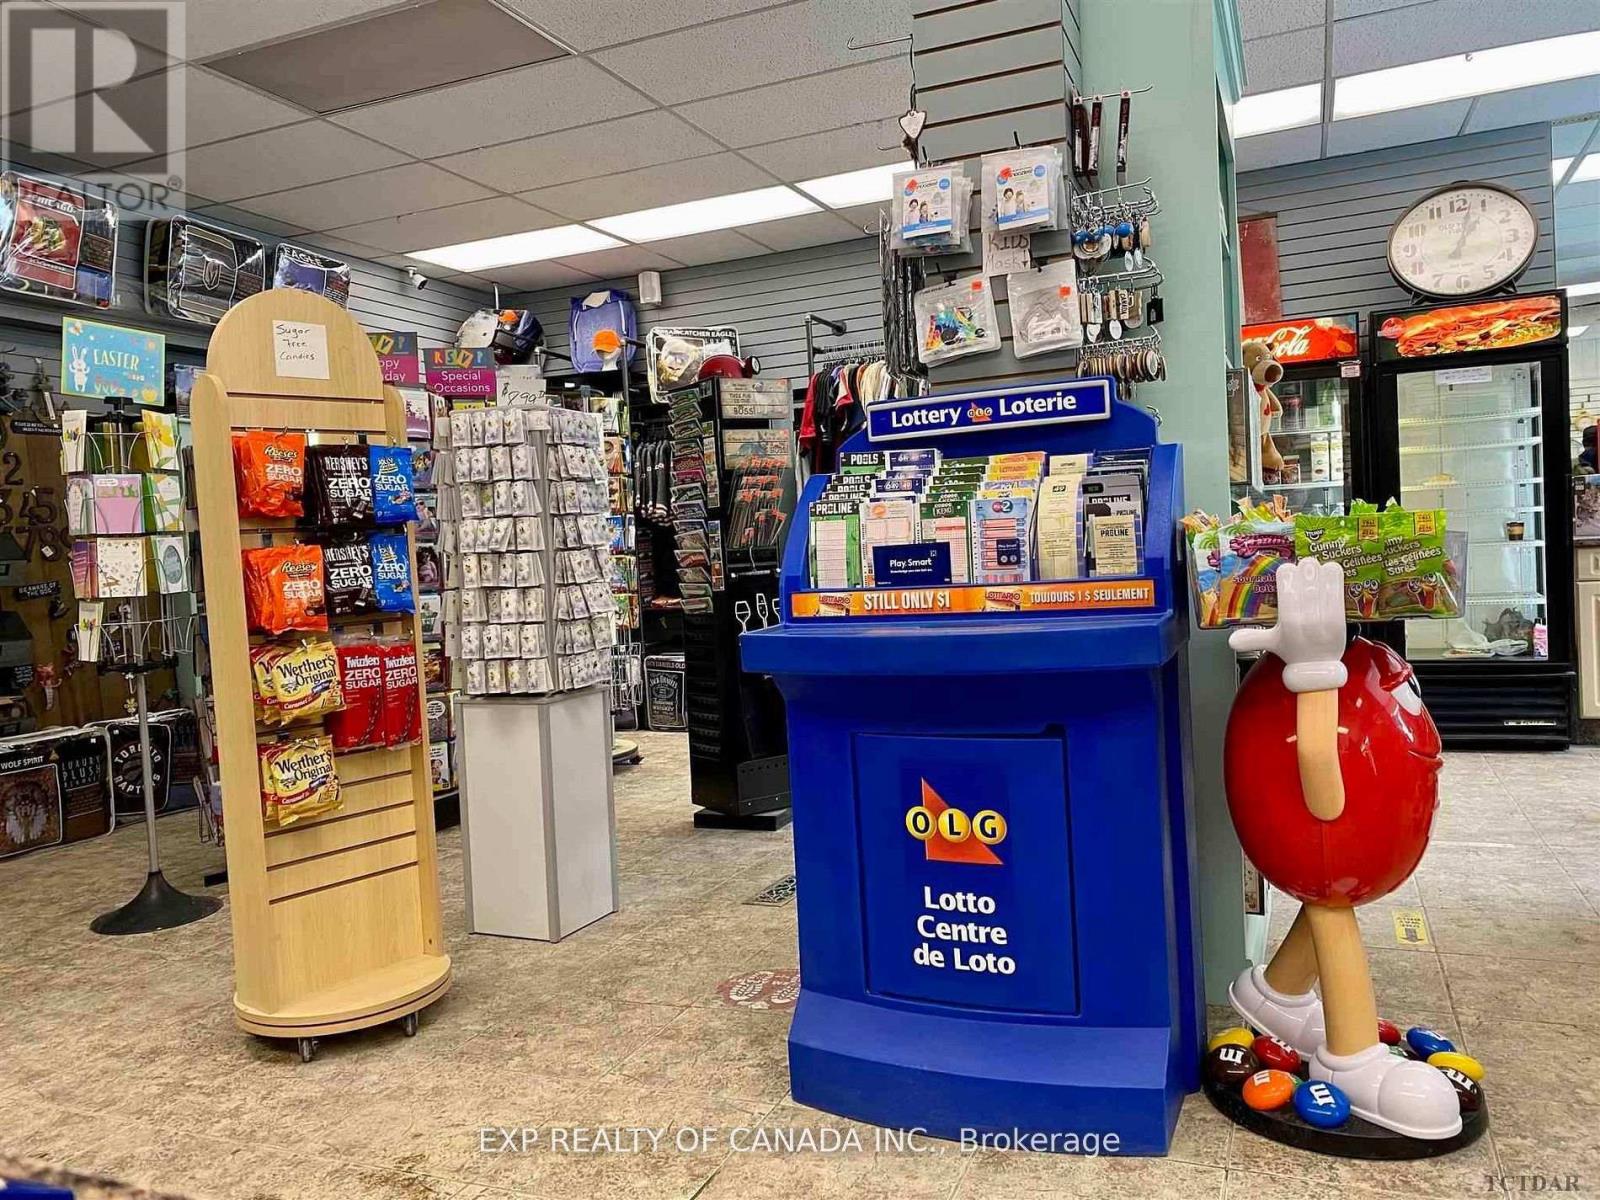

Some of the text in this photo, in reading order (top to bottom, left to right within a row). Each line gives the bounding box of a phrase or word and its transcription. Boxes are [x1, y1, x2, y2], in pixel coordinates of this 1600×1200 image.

[1450, 198, 1468, 213] 12
[1481, 199, 1487, 212] 1
[1429, 206, 1442, 220] 11
[1499, 209, 1512, 224] 2
[1408, 224, 1426, 238] 10
[1505, 228, 1520, 243] 3
[1403, 244, 1416, 258] 9
[1497, 248, 1513, 261] 4
[1482, 265, 1496, 280] 5
[1432, 274, 1444, 288] 7
[1456, 275, 1470, 289] 6
[94, 349, 140, 370] EASTER
[433, 350, 484, 368] RSVP
[442, 370, 481, 382] Special
[434, 383, 490, 393] Occasions
[892, 406, 962, 428] Lottery
[1000, 392, 1076, 416] Loterie
[265, 464, 302, 476] ZERO
[266, 473, 302, 484] SUGAR
[328, 478, 372, 488] ZERO
[374, 474, 406, 484] ZERO
[330, 488, 372, 498] SUGAR
[1322, 546, 1362, 560] Suckers
[377, 562, 407, 572] ZERO
[908, 558, 932, 567] Smart
[330, 565, 372, 580] ZERO
[378, 572, 408, 580] SUGAR
[282, 580, 320, 591] ZERO
[332, 577, 374, 588] SUGAR
[864, 592, 899, 610] STILL
[902, 592, 934, 610] ONLY
[937, 591, 950, 608] $1
[1030, 592, 1074, 604] TOUJOURS
[1094, 588, 1149, 600] SEULEMENT
[276, 654, 336, 678] Werther's
[344, 656, 380, 668] Twizzlers
[384, 656, 416, 668] Twizzlers
[296, 664, 336, 686] Original
[344, 667, 381, 680] ZERO
[385, 666, 417, 680] ZERO
[346, 678, 382, 690] SUGAR
[386, 677, 418, 690] SUGAR
[1, 755, 44, 770] WOLF SPIRIT
[275, 750, 332, 774] Werther's
[294, 763, 333, 780] Original
[912, 811, 997, 839] OLG
[924, 886, 996, 914] Lotto
[917, 915, 1008, 945] Centre
[914, 942, 1016, 974] de Loto
